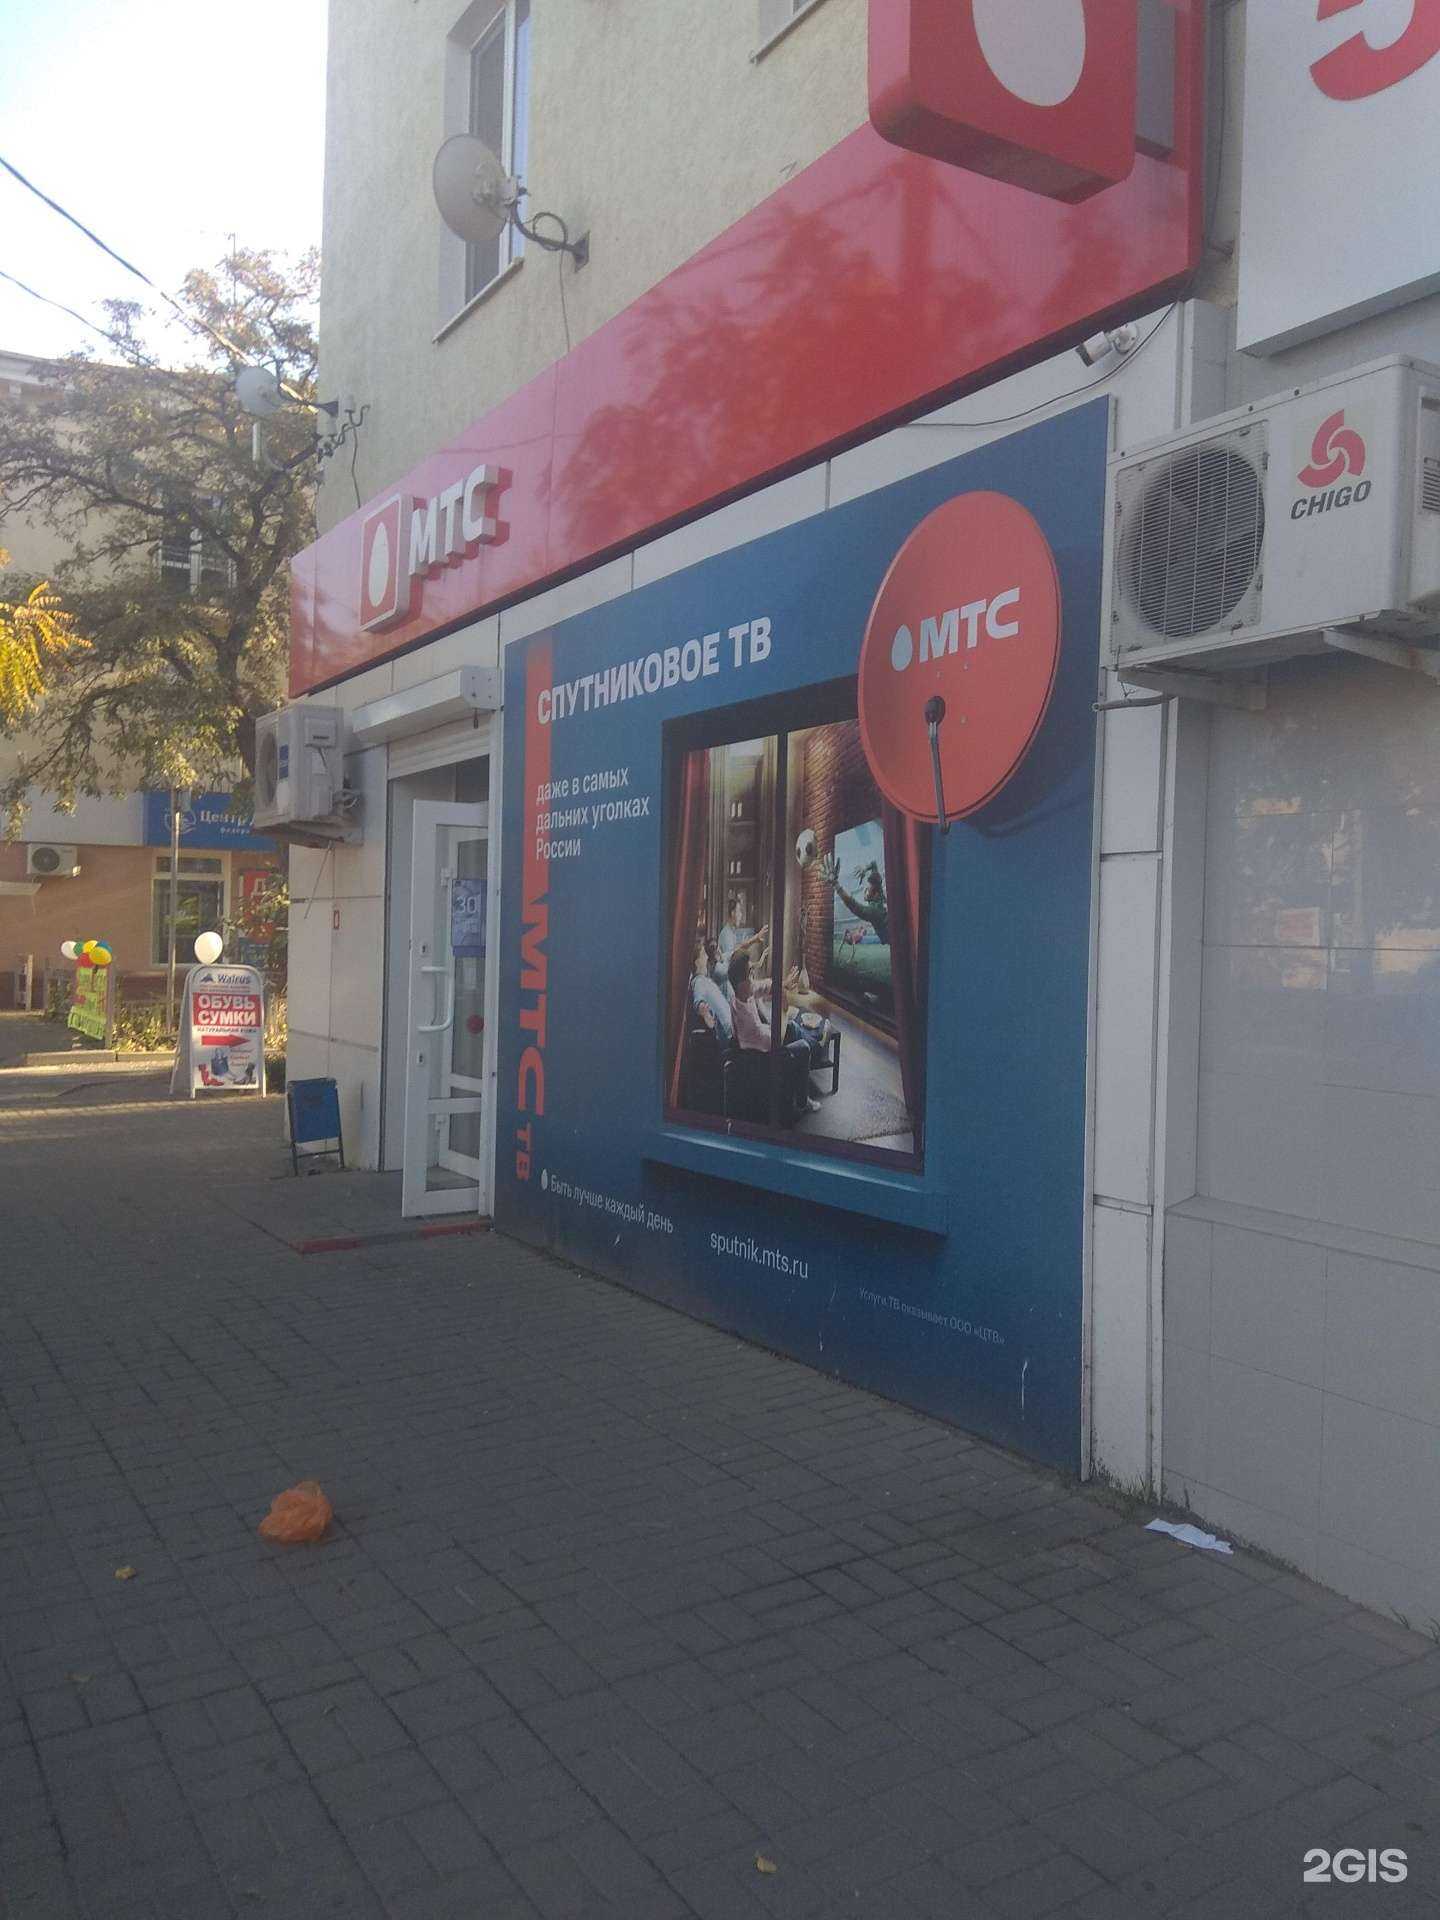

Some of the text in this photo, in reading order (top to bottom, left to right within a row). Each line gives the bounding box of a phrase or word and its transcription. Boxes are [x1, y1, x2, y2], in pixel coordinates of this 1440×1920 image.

[408, 464, 498, 577] МТС
[1290, 480, 1371, 520] CHIGO
[919, 586, 1020, 664] МТС
[537, 617, 772, 724] СПУТНИКОВОЕ ТВ
[535, 767, 630, 806] даже в самых
[535, 795, 650, 835] дальних уголках
[535, 837, 581, 861] России
[197, 1010, 256, 1025] СУМКИ
[198, 995, 255, 1010] ОБУВЬ
[517, 903, 549, 1116] МТС
[516, 1121, 532, 1181] ТВ
[551, 1174, 674, 1234] Быть лучше каждый день
[710, 1232, 808, 1279] sputnik.mts.ru
